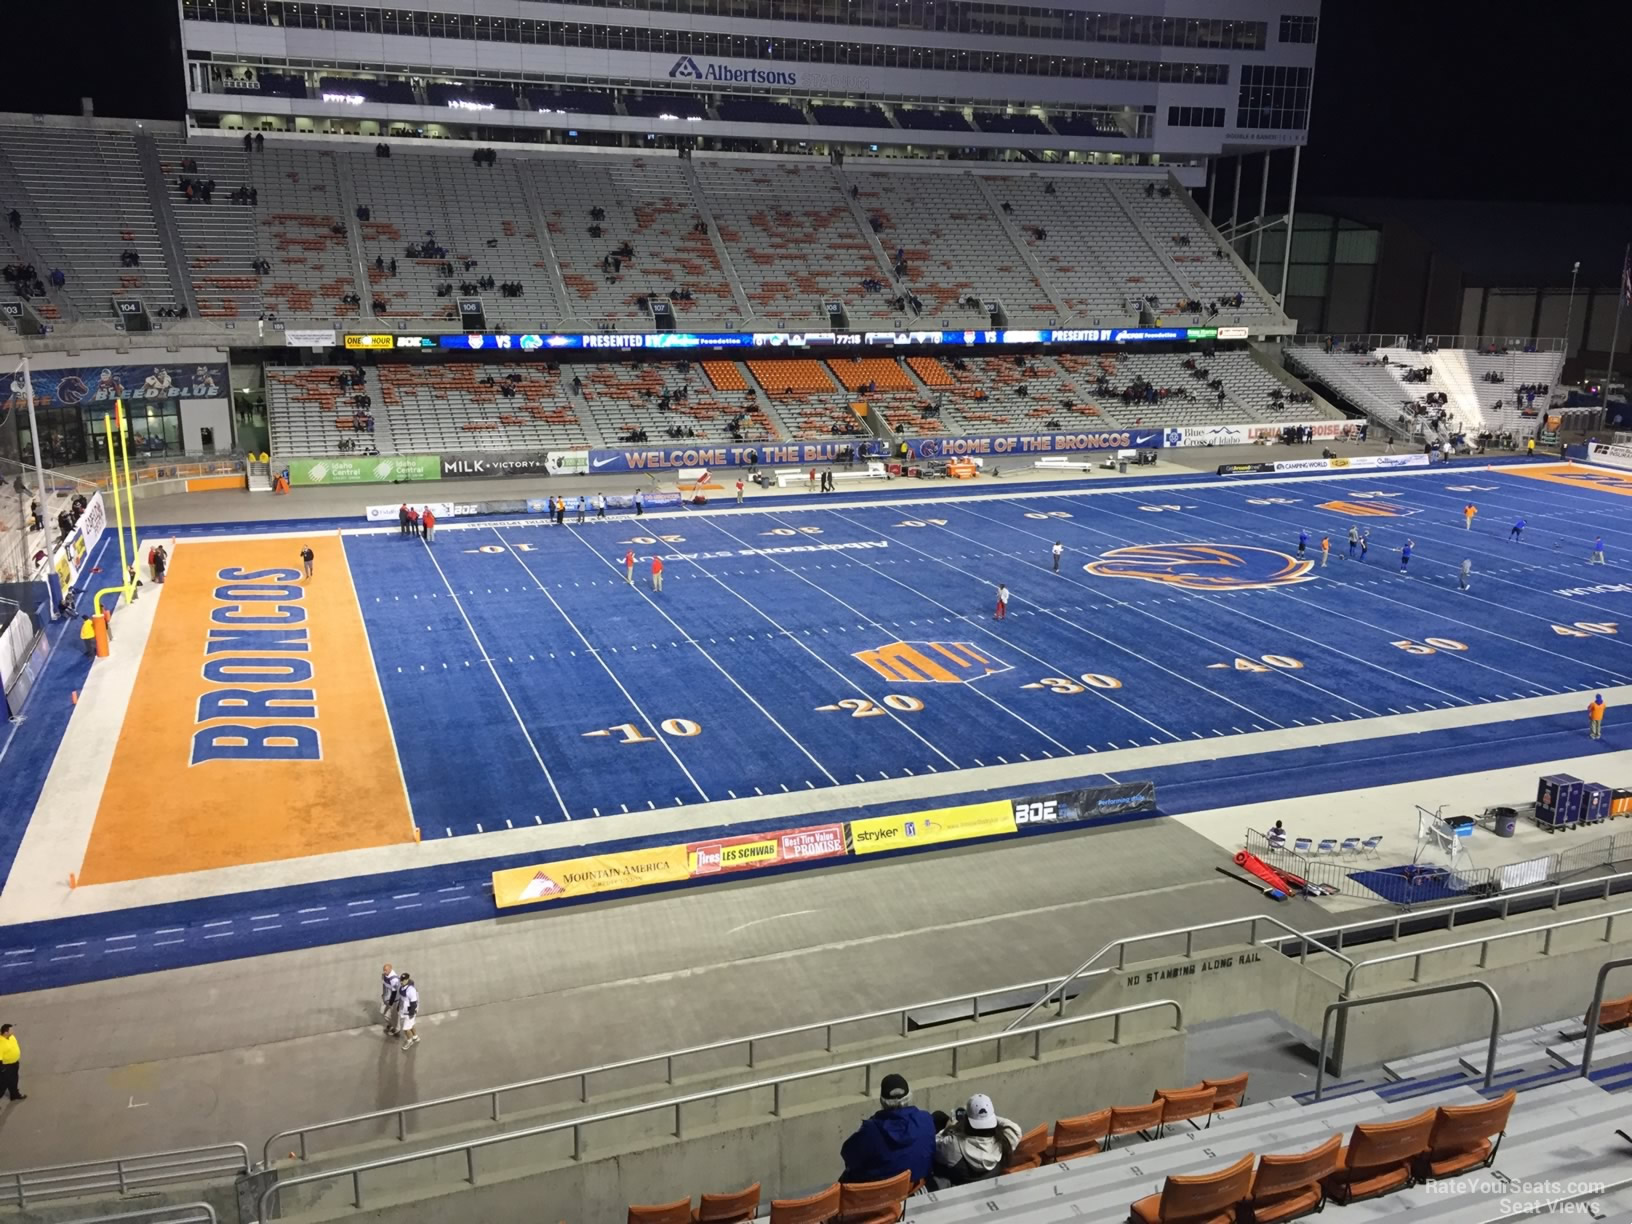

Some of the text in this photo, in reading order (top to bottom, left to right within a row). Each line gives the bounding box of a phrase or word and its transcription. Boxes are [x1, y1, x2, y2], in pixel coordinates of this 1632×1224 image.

[704, 63, 797, 86] Albertsons
[4, 306, 18, 314] 03
[121, 304, 136, 312] 104
[463, 303, 476, 311] 106
[654, 304, 665, 312] 107
[347, 337, 361, 345] ONE
[495, 335, 511, 348] VS
[582, 335, 642, 348] PRESENTED
[985, 331, 997, 343] VS
[1051, 330, 1099, 342] PRESENTED
[1101, 330, 1112, 342] BY
[95, 386, 220, 401] BLEED BLUE
[1184, 428, 1205, 437] Blue
[942, 432, 1130, 455] HOME OF THE BRONCOS
[1184, 437, 1208, 446] Cross
[1219, 436, 1241, 445] Idaho
[625, 448, 727, 469] WELCOME
[731, 447, 758, 464] TO
[762, 446, 800, 462] THE
[396, 466, 424, 474] Central
[444, 460, 535, 473] MILK VICTORY
[631, 534, 687, 546] 20
[738, 539, 889, 557] Albertsons
[1390, 637, 1469, 655] 50
[187, 567, 323, 768] BRONCOS
[1235, 654, 1304, 673] 40
[1039, 673, 1123, 695] 30
[837, 694, 925, 718] 20
[608, 718, 702, 744] 10
[1097, 795, 1130, 807] Performing
[784, 832, 834, 847] Best Tire Value
[857, 827, 899, 842] stryker
[722, 844, 775, 861] LES SCHWAB
[794, 839, 842, 857] PROMISE
[698, 850, 720, 867] Tires
[563, 861, 671, 884] MOUNTAIN AMERICA
[1127, 952, 1262, 987] NO STANDING ALONG RAIL
